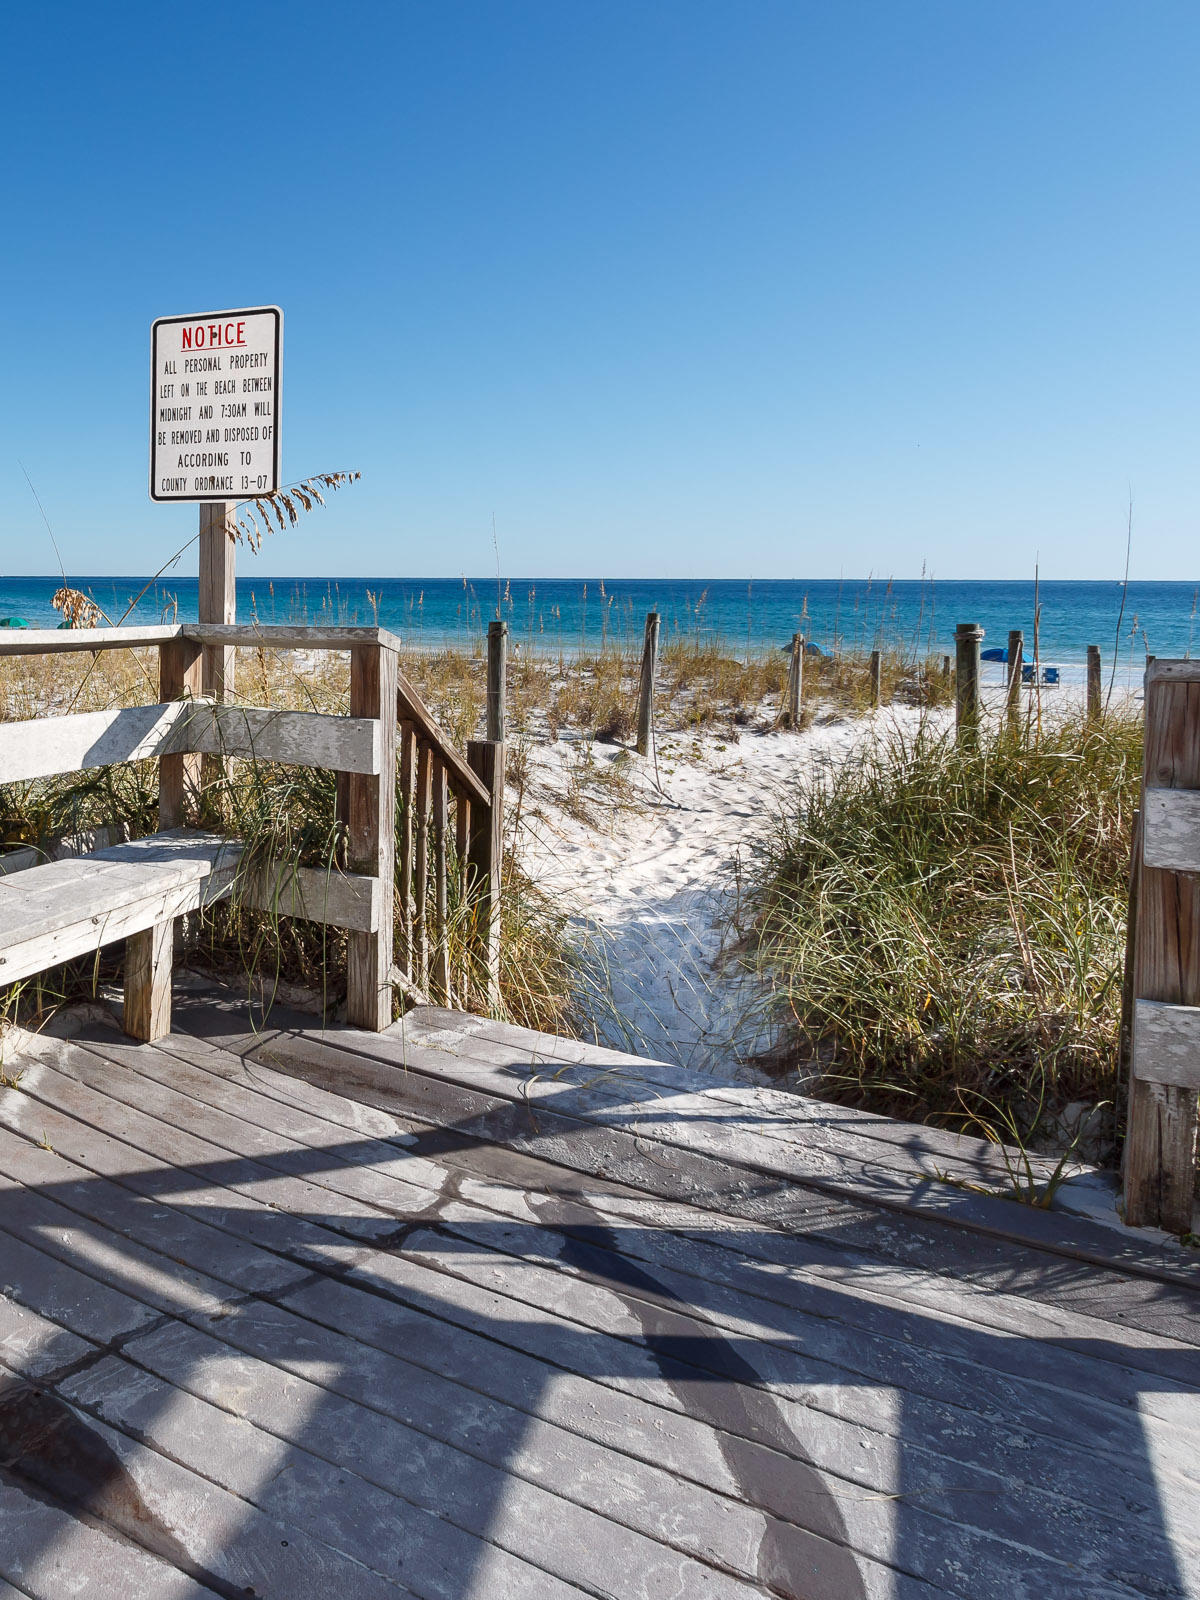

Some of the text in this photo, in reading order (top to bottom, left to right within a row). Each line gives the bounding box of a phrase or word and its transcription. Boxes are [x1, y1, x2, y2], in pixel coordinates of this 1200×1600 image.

[182, 322, 245, 348] NOTICE
[164, 353, 268, 374] ALL PERSONAL PROPERTY
[160, 377, 271, 398] LEFT ON THE BEACH BETWEEN
[160, 402, 271, 422] MIDNIGHT AND 7:30AM WILL
[158, 426, 272, 445] BE REMOVED AND DISPOSED OF
[178, 452, 251, 468] ACCORDING TO
[162, 478, 187, 491] COUNTY
[241, 475, 267, 489] 13-07
